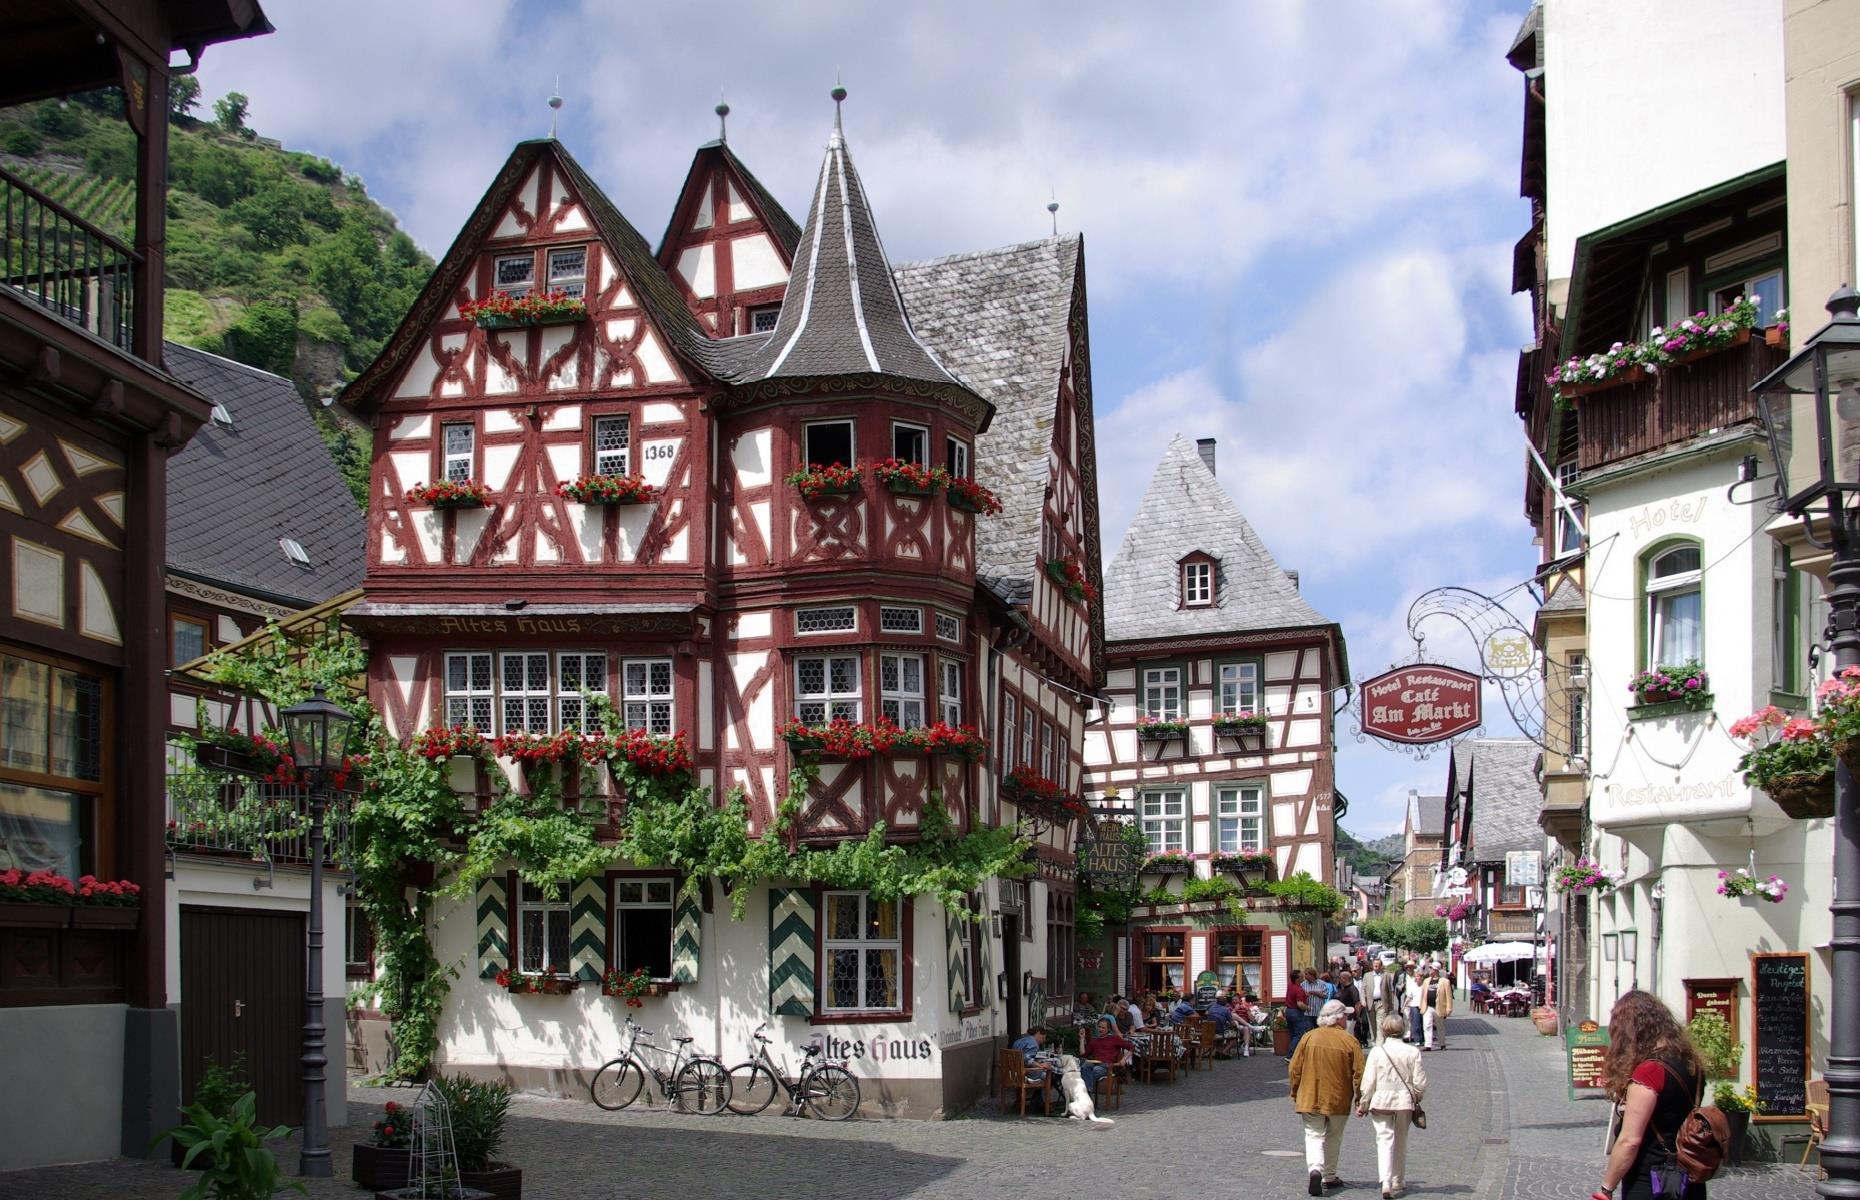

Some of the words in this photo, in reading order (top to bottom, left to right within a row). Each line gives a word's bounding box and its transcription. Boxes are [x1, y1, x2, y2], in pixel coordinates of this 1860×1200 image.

[645, 444, 674, 460] 1368
[1629, 496, 1708, 540] Hotel
[440, 616, 507, 635] Altes
[517, 616, 581, 635] Haus
[1371, 678, 1402, 698] Hotel
[1406, 675, 1474, 692] Restaurant
[1400, 687, 1440, 704] Café
[1372, 705, 1404, 723] Am
[1411, 701, 1471, 723] Markt
[1608, 774, 1735, 808] Restaurant
[1100, 832, 1120, 841] HAUS
[1088, 843, 1129, 858] ALTES
[1088, 857, 1129, 873] HAUS
[1759, 962, 1805, 979] Heutiges
